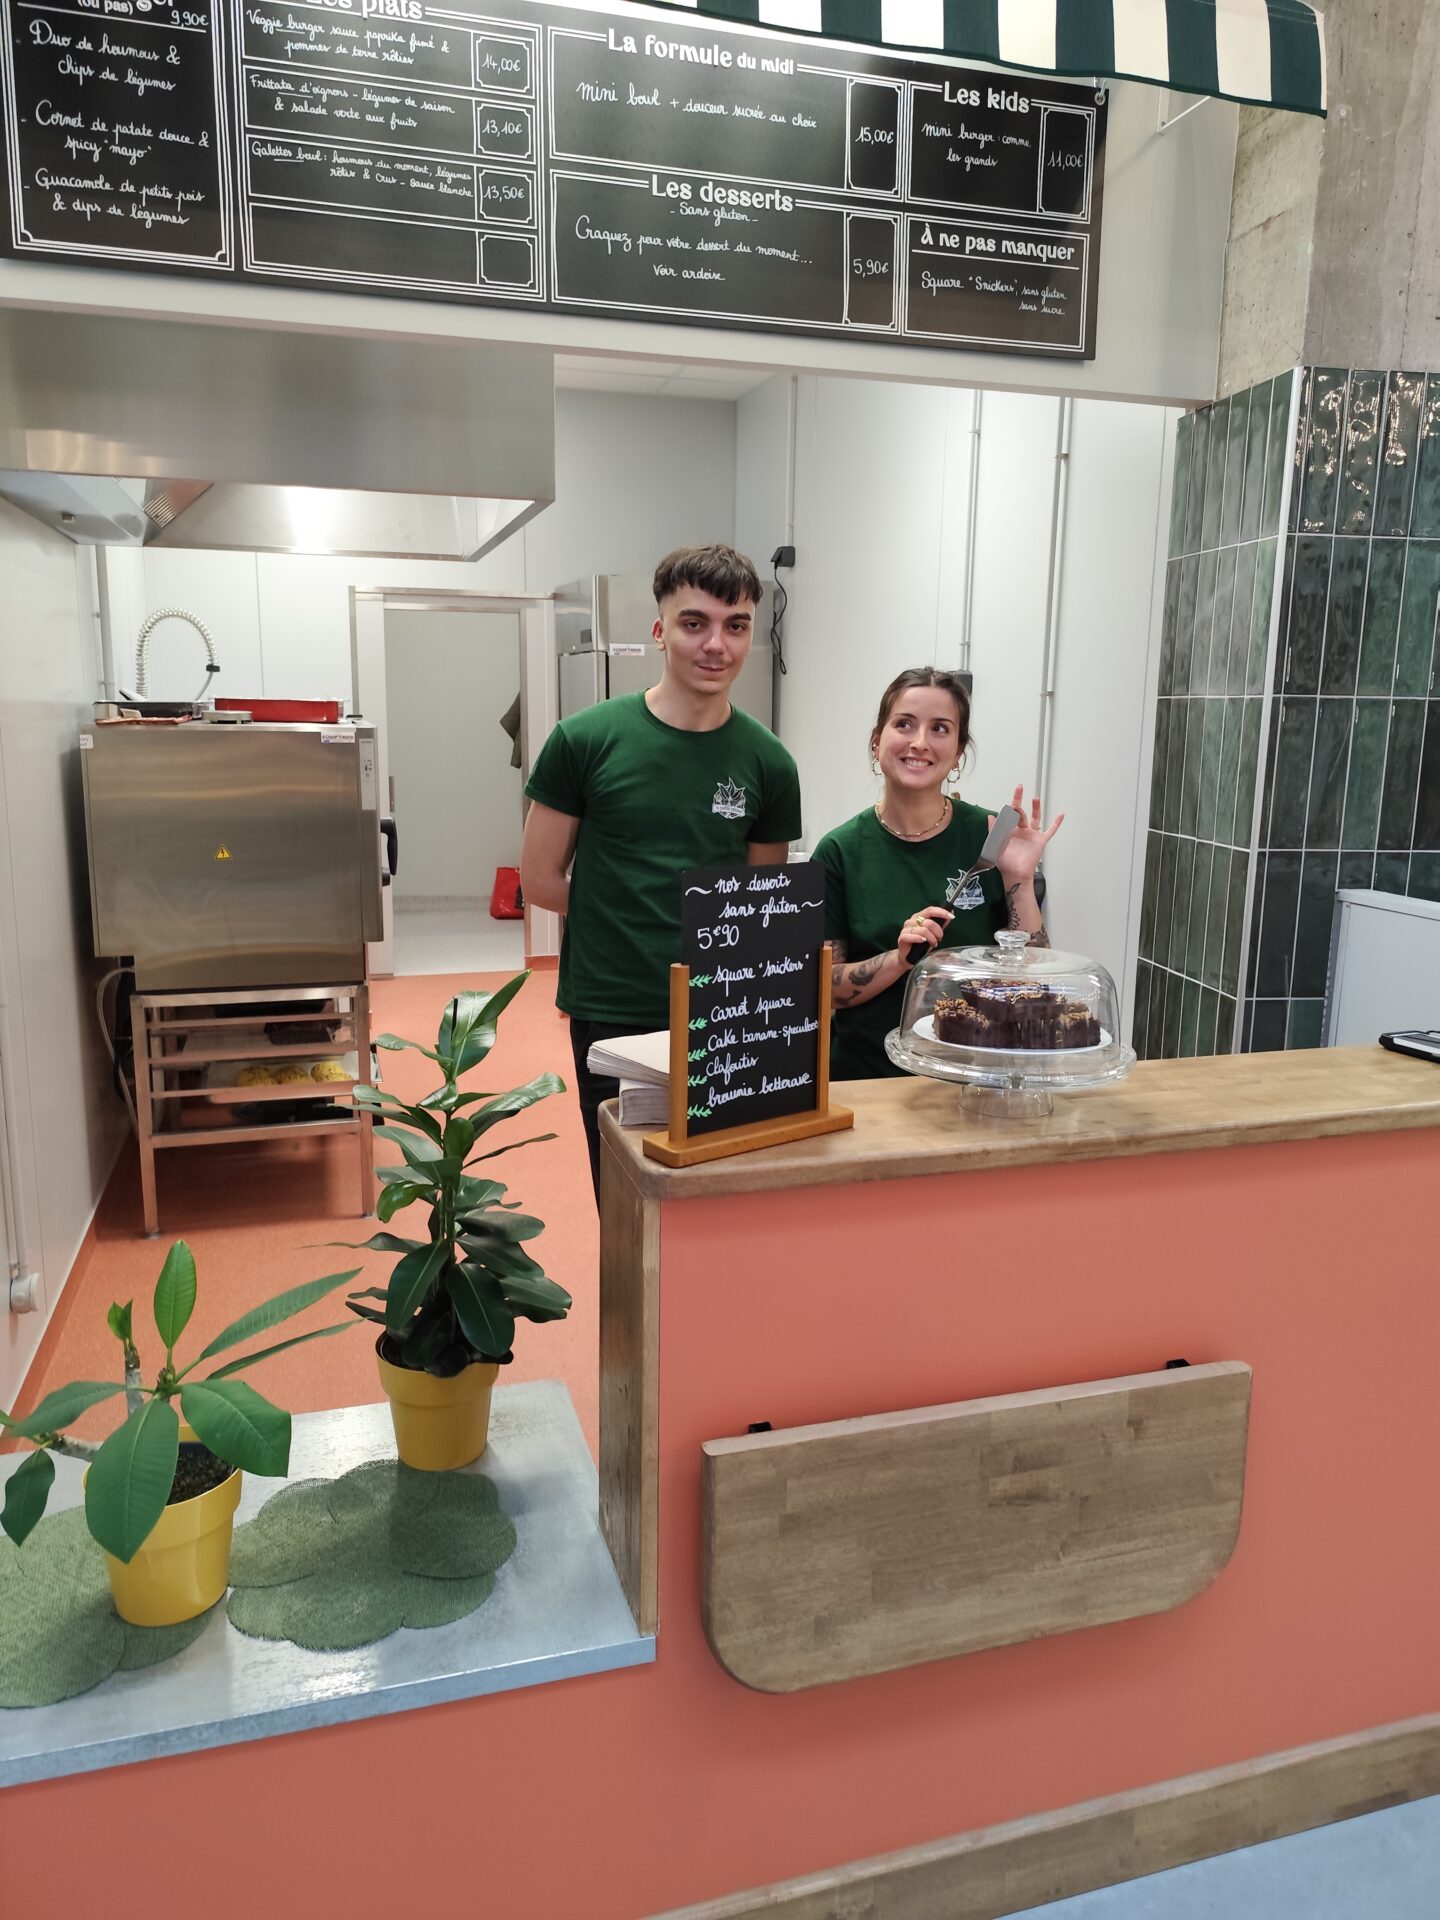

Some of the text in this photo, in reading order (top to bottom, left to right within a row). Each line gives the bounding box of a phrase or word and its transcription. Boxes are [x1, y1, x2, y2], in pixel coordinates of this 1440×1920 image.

[170, 10, 209, 28] 9,90€
[361, 0, 423, 19] plats
[29, 19, 180, 65] Duo de houmous &
[246, 9, 283, 34] Veggie
[287, 14, 325, 41] burger
[330, 24, 360, 39] sauce
[410, 32, 435, 53] fumé
[441, 40, 450, 54] &
[285, 40, 414, 65] pommes de terre rôties
[608, 28, 794, 75] La formule du midi
[482, 55, 521, 76] 14,00€
[99, 69, 118, 81] de
[124, 69, 176, 96] légumes
[250, 74, 295, 92] Frittata
[299, 79, 349, 105] d'oignons
[362, 89, 402, 108] légumes
[405, 95, 416, 107] de
[424, 101, 455, 114] saison
[576, 80, 618, 102] mini
[670, 97, 679, 108] +
[682, 101, 728, 115] douceur
[732, 105, 766, 119] sucrée
[769, 114, 786, 123] au
[792, 114, 817, 129] choix
[944, 81, 1030, 113] Les kids
[35, 99, 210, 148] Cornet de patate douce &
[275, 97, 418, 131] & salade verte aux fruits
[482, 119, 523, 139] 13,10€
[855, 127, 894, 147] 15,00€
[922, 122, 953, 137] mini
[958, 123, 994, 149] burger
[1002, 135, 1031, 147] comme
[64, 135, 102, 162] spicy
[947, 148, 998, 171] les grands
[1047, 151, 1083, 170] 11,00€
[251, 142, 293, 158] Galettes
[331, 151, 373, 168] houmous
[376, 158, 392, 170] du
[394, 164, 432, 178] moment,
[436, 167, 472, 187] légumes
[35, 167, 206, 212] Guacamole de petits pois
[330, 168, 356, 178] rôtis
[363, 171, 371, 182] &
[438, 181, 474, 198] blanche
[482, 185, 525, 203] 13,50€
[652, 175, 793, 211] Les desserts
[52, 193, 190, 229] & dips de légumes
[679, 202, 710, 216] Sans
[713, 208, 750, 226] gluten
[575, 215, 631, 254] Craquez
[638, 233, 663, 254] pour
[666, 239, 691, 251] votre
[697, 237, 730, 252] dessert
[734, 244, 751, 253] du
[921, 223, 1075, 262] À ne pas manquer
[653, 264, 726, 281] Voir ardoise
[854, 260, 889, 278] 5,90€
[921, 271, 964, 296] Square
[1021, 286, 1039, 296] sans
[1041, 287, 1068, 304] gluten
[1019, 301, 1065, 314] sans sucre
[715, 872, 791, 893] nos desserts
[718, 896, 800, 928] sans gluten
[697, 924, 739, 949] 5€90
[755, 997, 795, 1025] square
